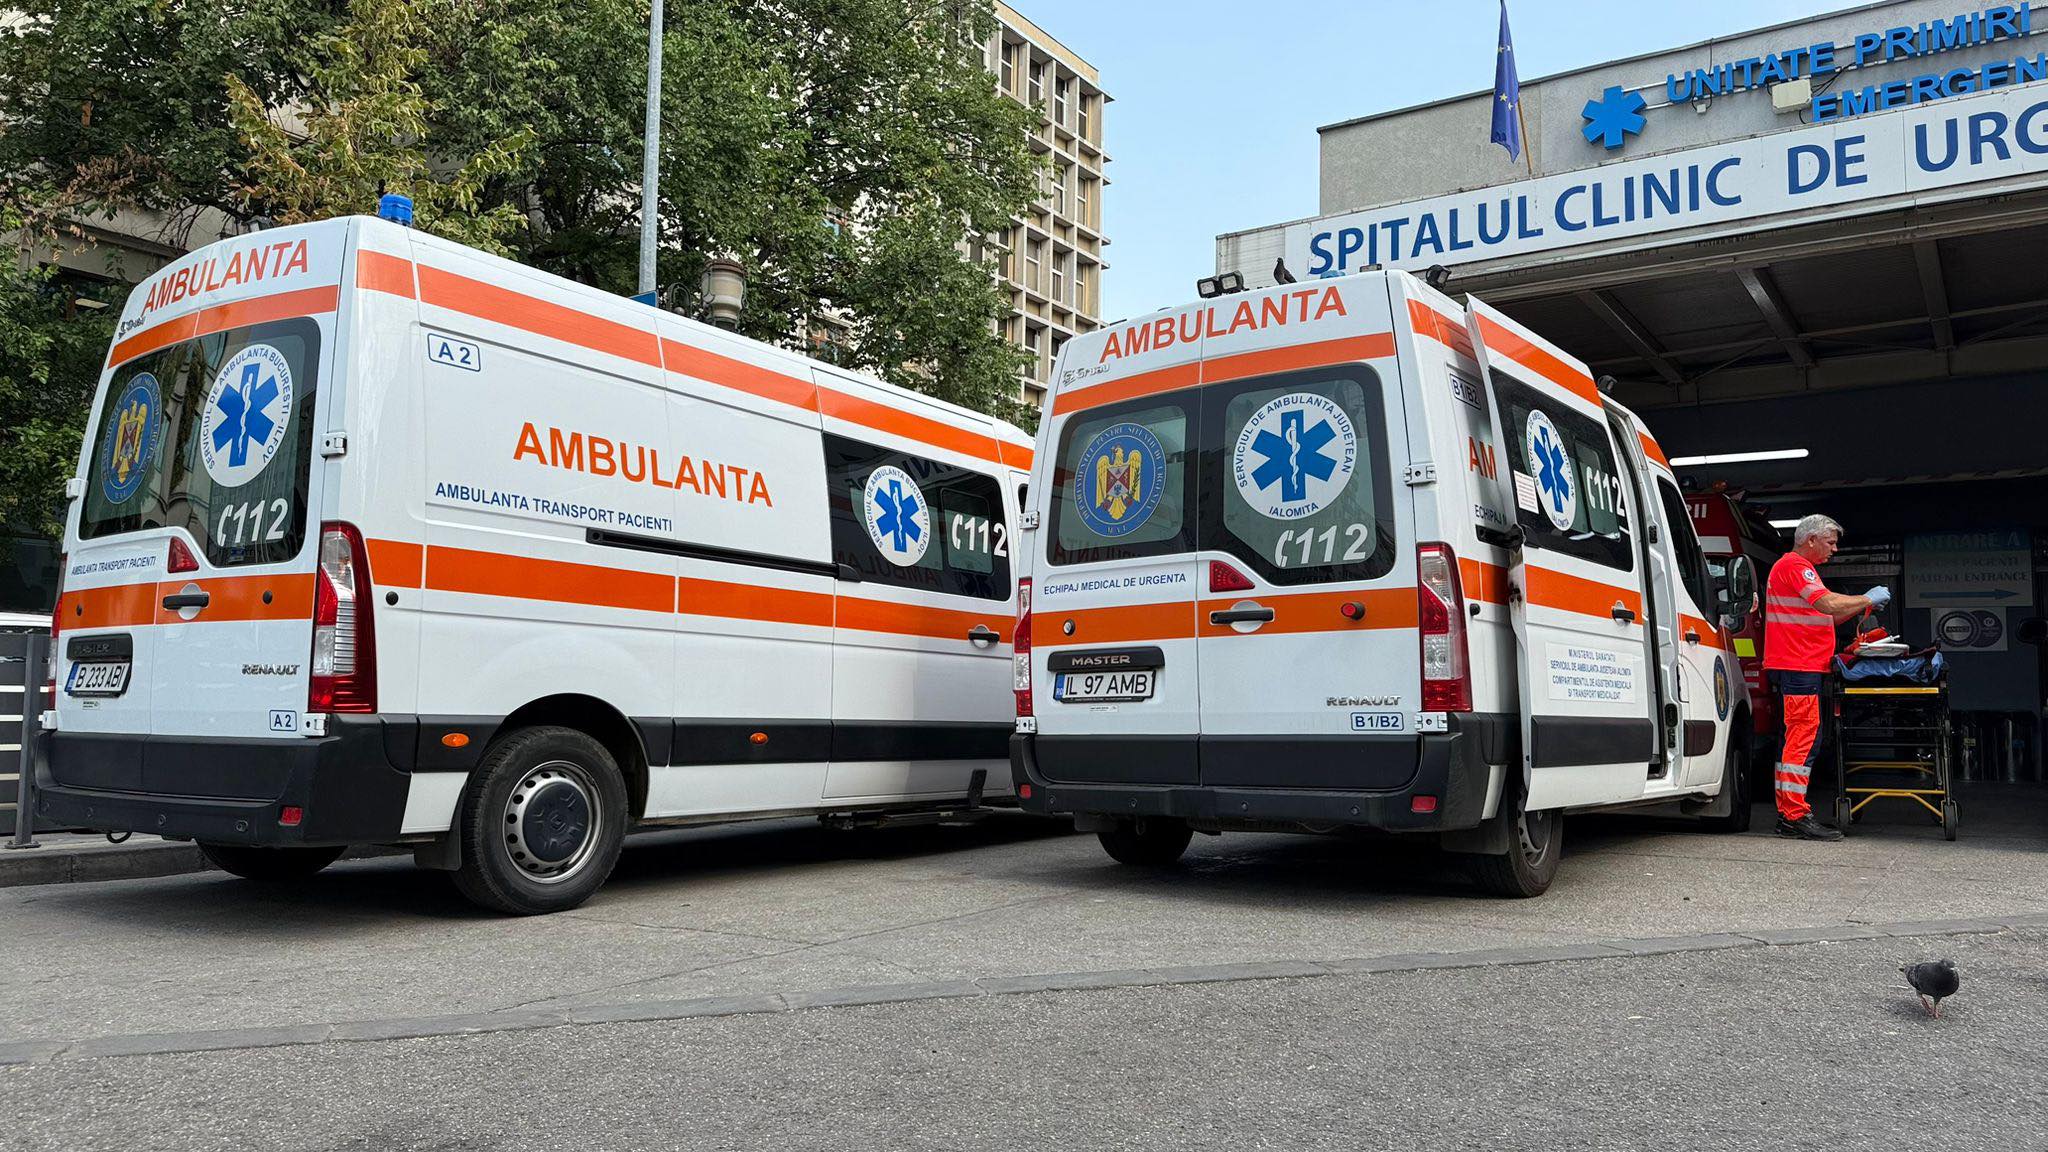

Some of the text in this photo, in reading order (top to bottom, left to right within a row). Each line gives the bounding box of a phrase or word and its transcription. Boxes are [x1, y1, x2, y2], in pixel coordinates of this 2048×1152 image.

[1666, 2, 2031, 104] UNITATE PRIMIRI
[1309, 195, 1543, 274] SPITALUL
[1554, 157, 1742, 232] CLINIC
[1788, 134, 1867, 195] DE
[141, 239, 307, 317] AMBULANTA
[1099, 285, 1347, 363] AMBULANTA
[218, 347, 269, 387] AMBULANTA
[438, 342, 472, 365] A 2
[209, 387, 219, 404] DE
[268, 351, 291, 415] BUCURESTI
[202, 407, 215, 469] SERVICIUL
[263, 425, 284, 464] ILFOV
[1236, 395, 1355, 488] SERVICIUL DE AMBULANTA JUDETEAN
[513, 422, 774, 508] AMBULANTA
[871, 468, 904, 489] AMBULANTA
[435, 482, 673, 532] AMBULANTA TRANSPORT PACIENTI
[867, 488, 873, 500] DE
[1268, 502, 1320, 518] IALOMITA
[233, 498, 288, 544] 112
[864, 500, 884, 549] SERVICIUL
[964, 517, 1008, 558] 112
[1295, 523, 1368, 564] 112
[71, 556, 157, 576] AMBULANTA TRANSPORT PACIENTI
[1044, 573, 1187, 595] ECHIPAJ MEDICAL DE URGENTA
[1964, 570, 2028, 583] ENTRANCE
[75, 665, 126, 688] B 233 ABI
[241, 664, 300, 676] RENAULT
[1071, 655, 1131, 666] MASTER
[1065, 676, 1078, 696] IL
[1084, 675, 1104, 695] 97
[1106, 674, 1148, 695] AMB
[1326, 696, 1402, 707] RENAULT
[274, 714, 292, 728] A 2
